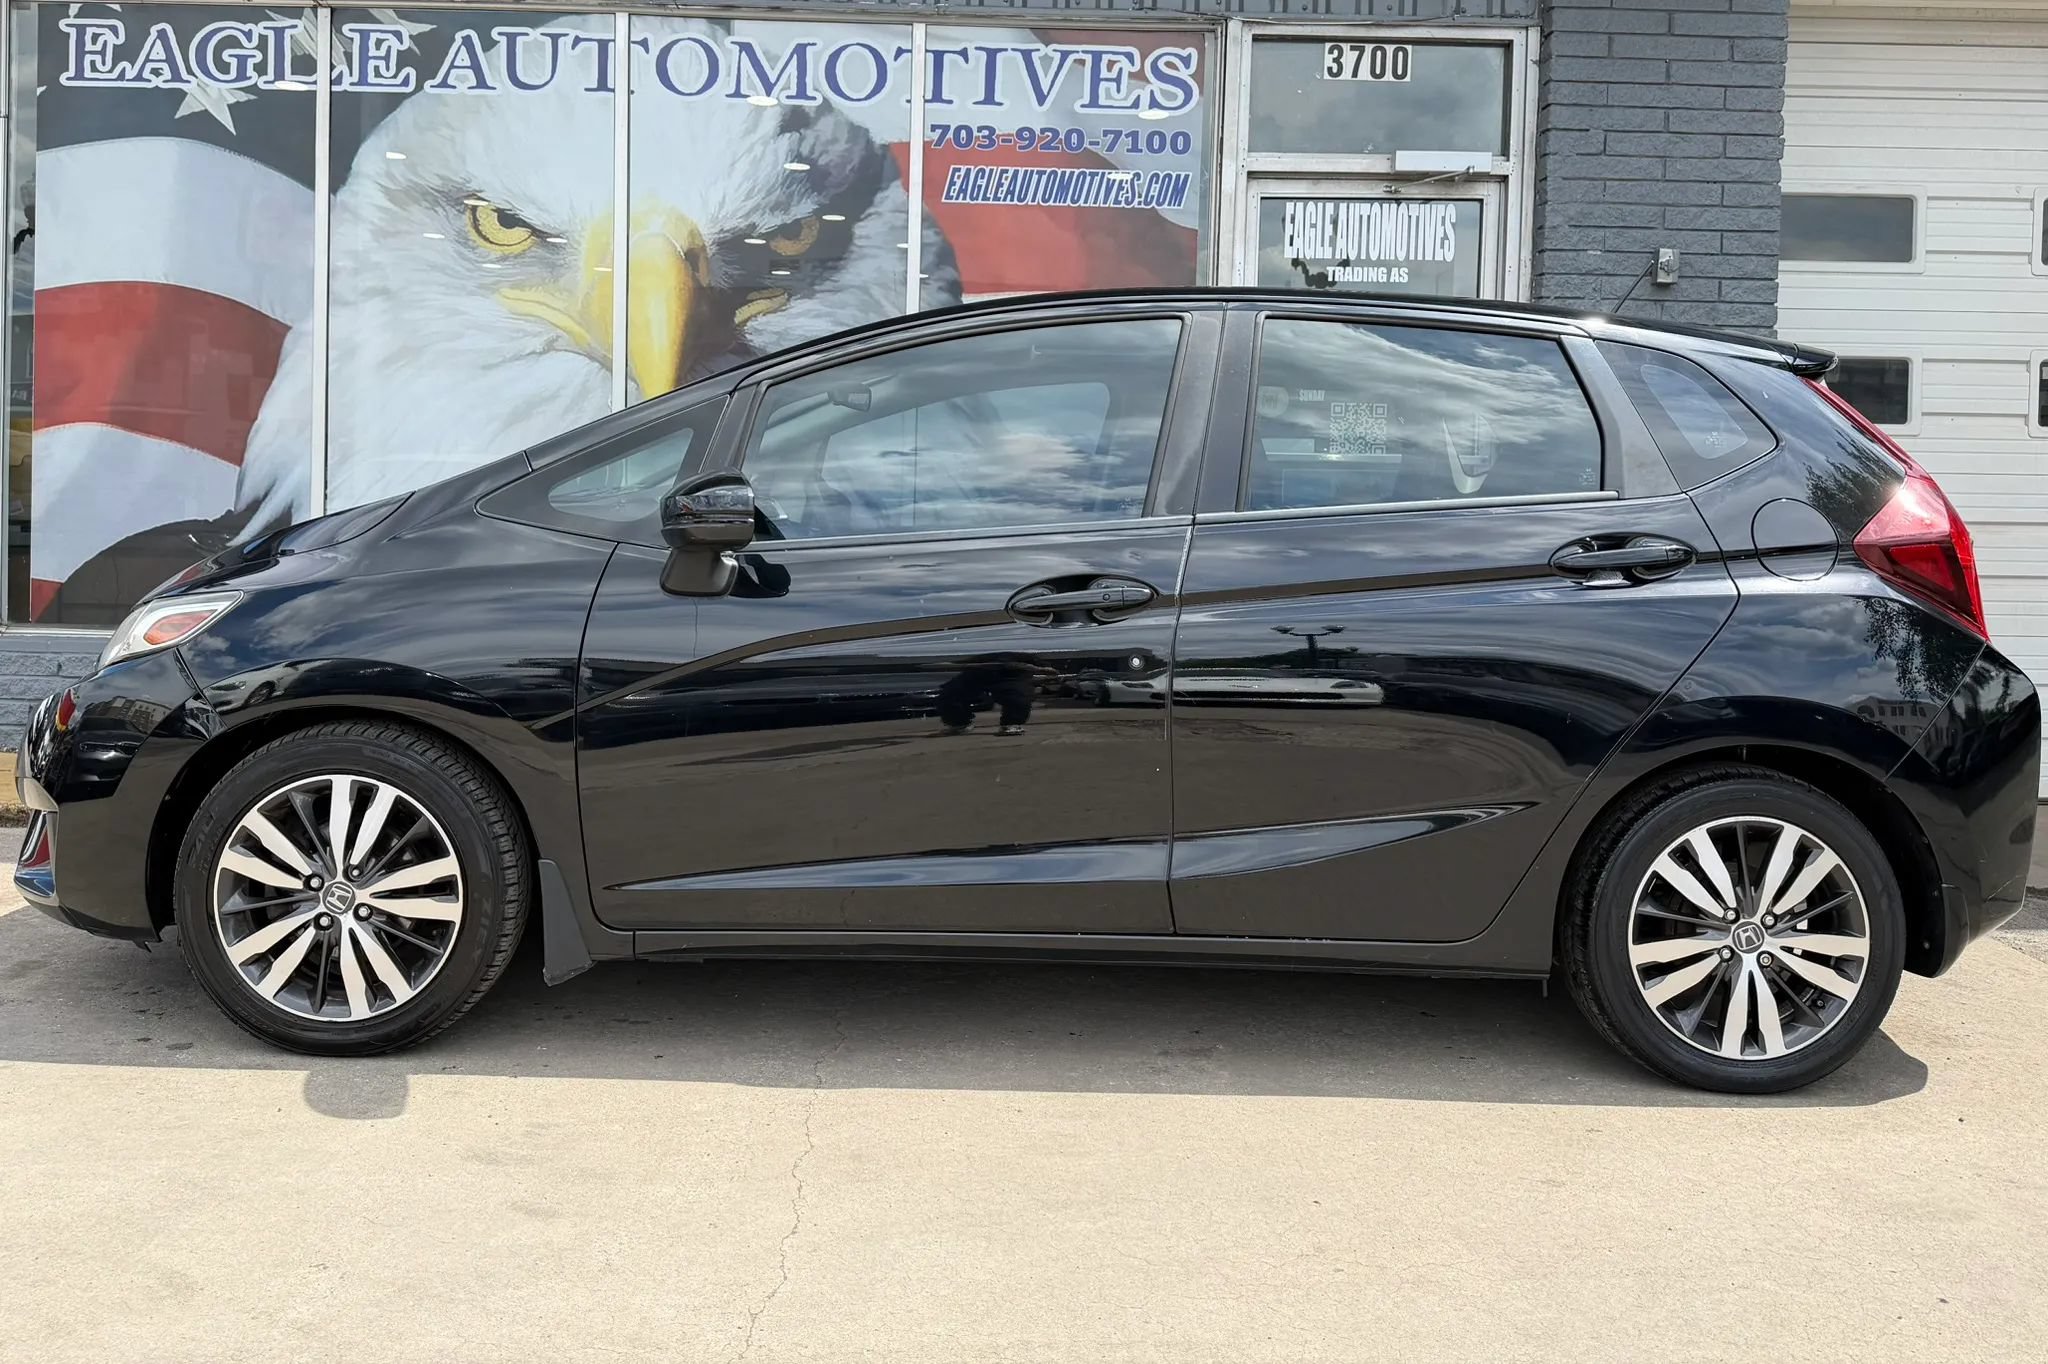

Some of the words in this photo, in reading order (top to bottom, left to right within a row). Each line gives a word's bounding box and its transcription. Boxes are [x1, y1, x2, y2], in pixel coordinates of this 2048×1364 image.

[59, 19, 416, 92] EAGLE
[424, 27, 1200, 114] AUTOMOTIVES
[1326, 43, 1410, 80] 3700
[930, 123, 1191, 155] 703-920-7100
[941, 164, 1191, 209] EAGLEAUTOMOTIVES.COM
[1284, 201, 1334, 259] EAGLE
[1335, 202, 1456, 262] AUTOMOTIVES
[1326, 266, 1387, 283] TRADING
[1389, 267, 1409, 283] AS
